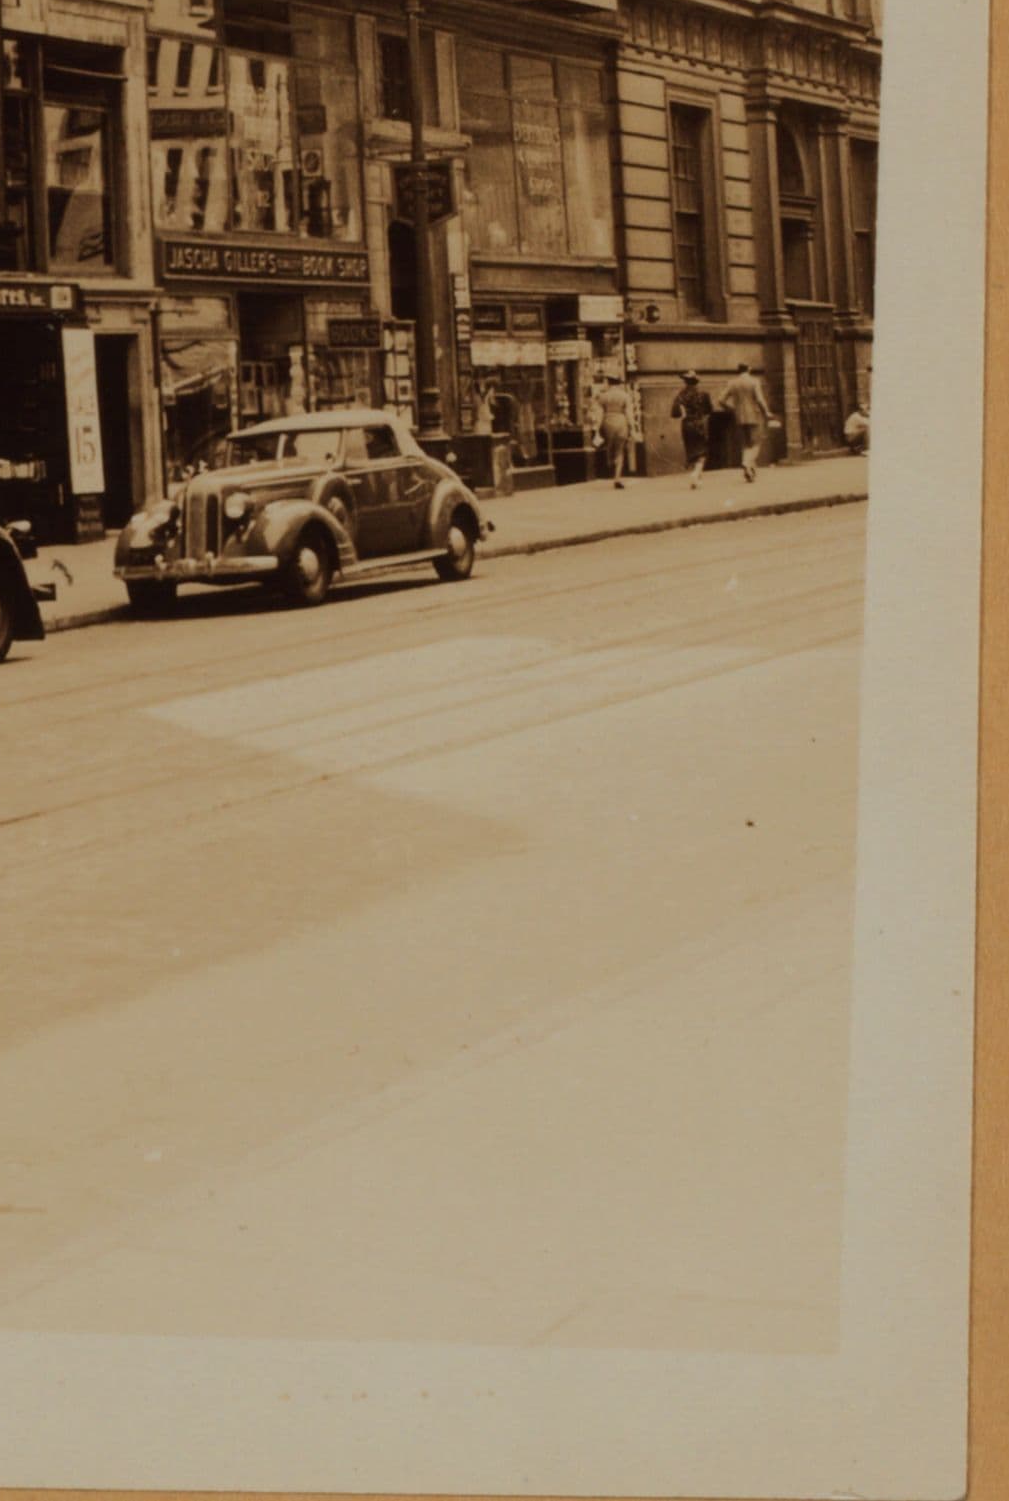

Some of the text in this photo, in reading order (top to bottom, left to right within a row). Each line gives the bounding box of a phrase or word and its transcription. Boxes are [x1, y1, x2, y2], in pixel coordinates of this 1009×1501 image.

[169, 247, 219, 270] JASCHA
[302, 255, 334, 276] BOOK
[337, 257, 367, 278] SHOP
